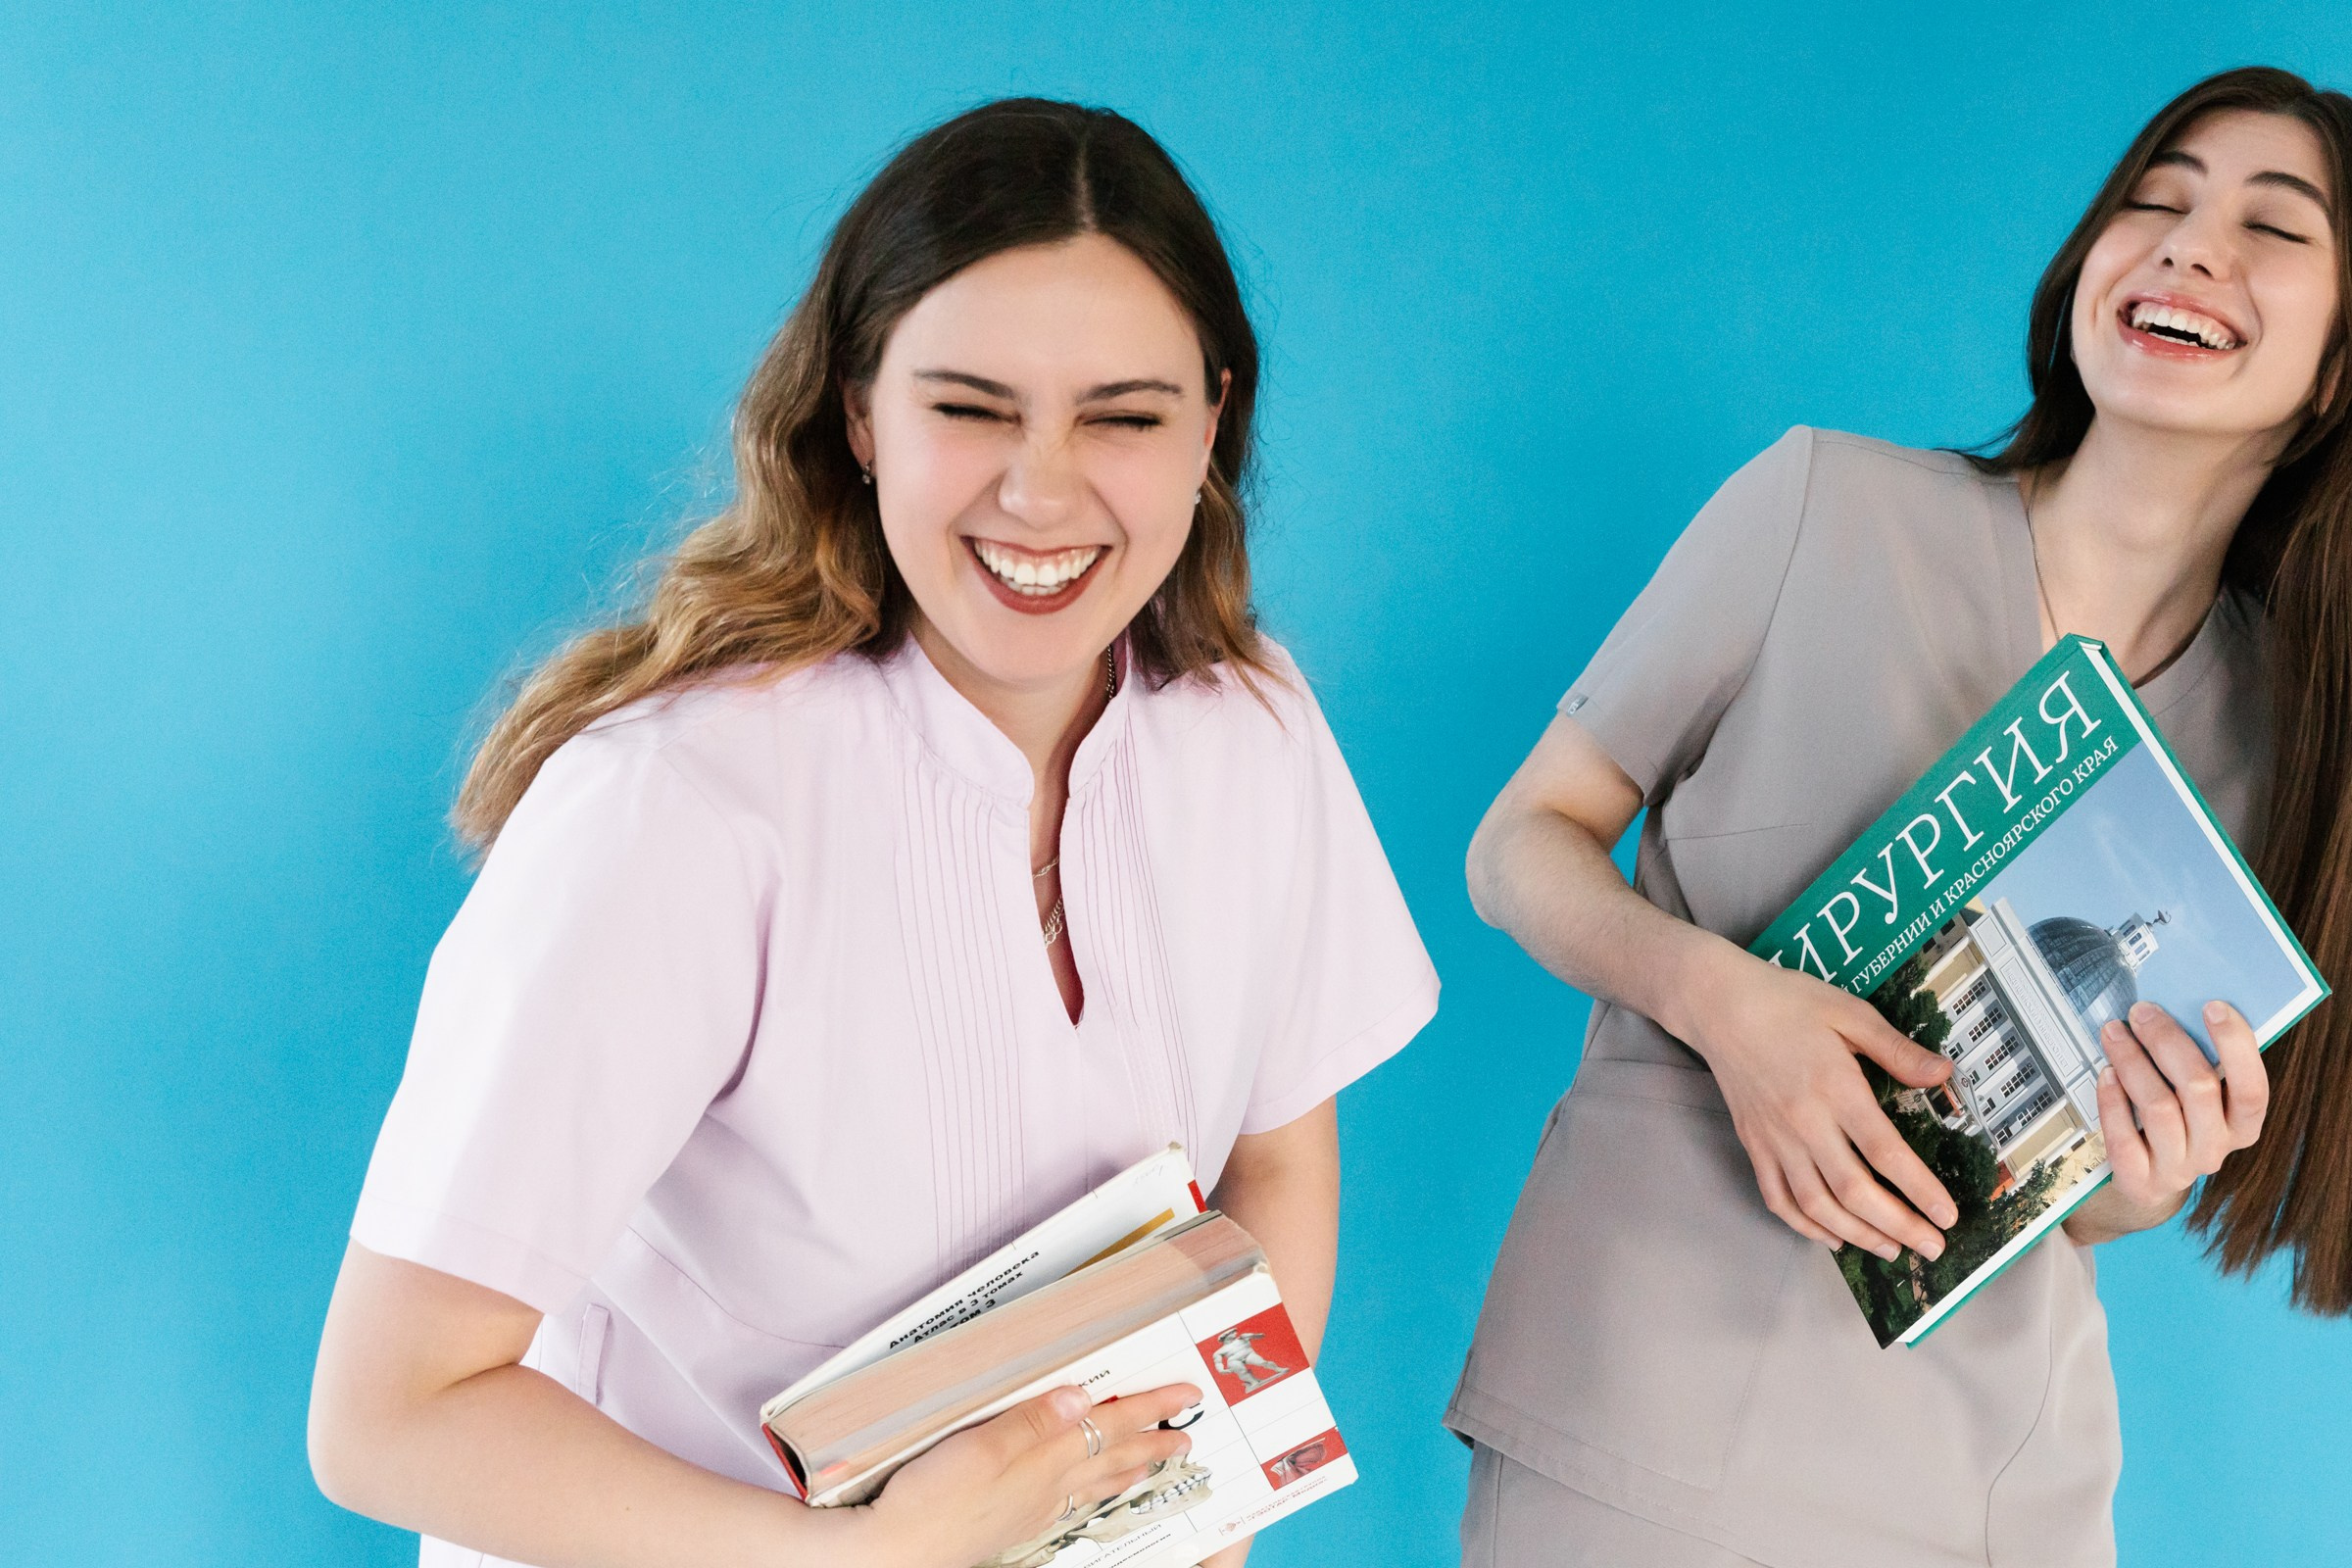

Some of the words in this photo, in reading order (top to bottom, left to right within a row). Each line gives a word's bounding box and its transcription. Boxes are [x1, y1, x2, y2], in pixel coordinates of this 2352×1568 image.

[1850, 911, 1933, 994] ГУБЕРНИИ
[1929, 898, 1947, 919] И
[1942, 777, 2075, 906] КРАСНОЯРСКОГО
[2071, 735, 2119, 784] КРАЯ
[889, 1298, 964, 1349] Анатомия
[966, 1250, 1040, 1298] человека
[913, 1314, 956, 1345] Атлас
[957, 1306, 967, 1315] в
[969, 1298, 979, 1307] 3
[982, 1271, 1024, 1298] томах
[985, 1298, 997, 1309] 3
